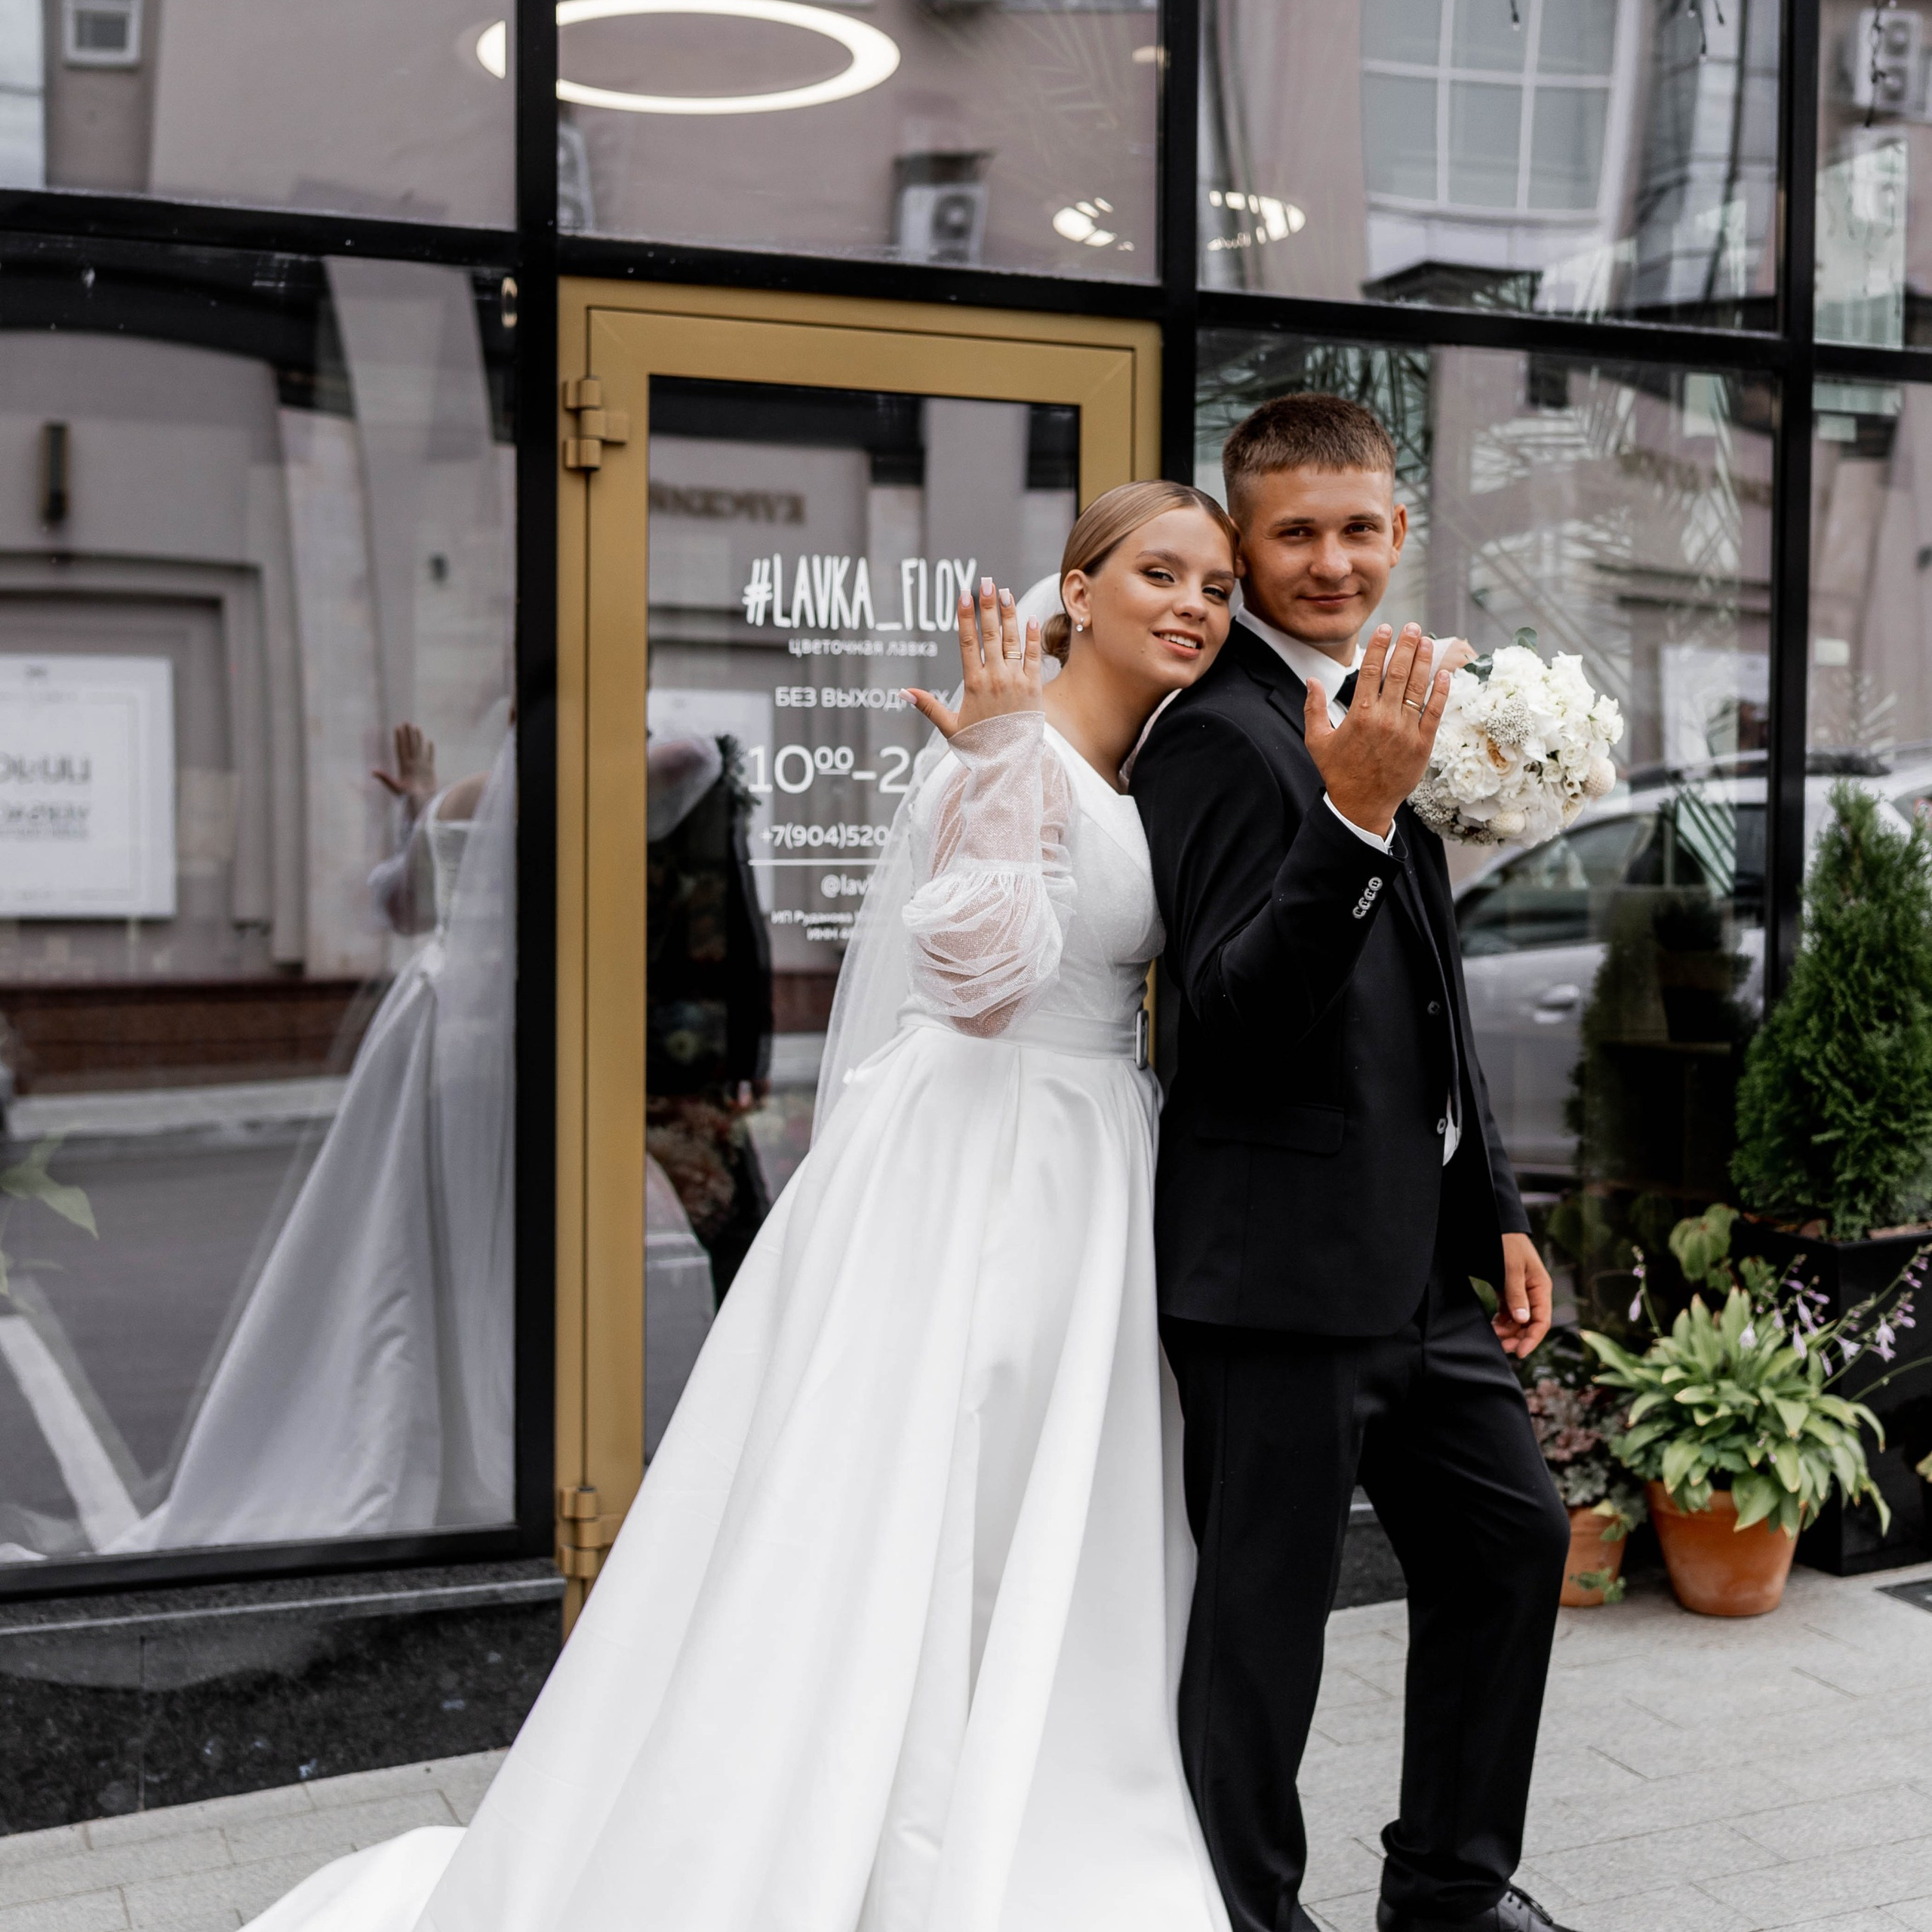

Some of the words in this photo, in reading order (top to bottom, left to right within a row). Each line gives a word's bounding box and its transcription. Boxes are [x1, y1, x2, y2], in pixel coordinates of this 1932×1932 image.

[788, 638, 884, 658] цветочная
[886, 640, 939, 657] лавка
[774, 686, 817, 708] БЕЗ
